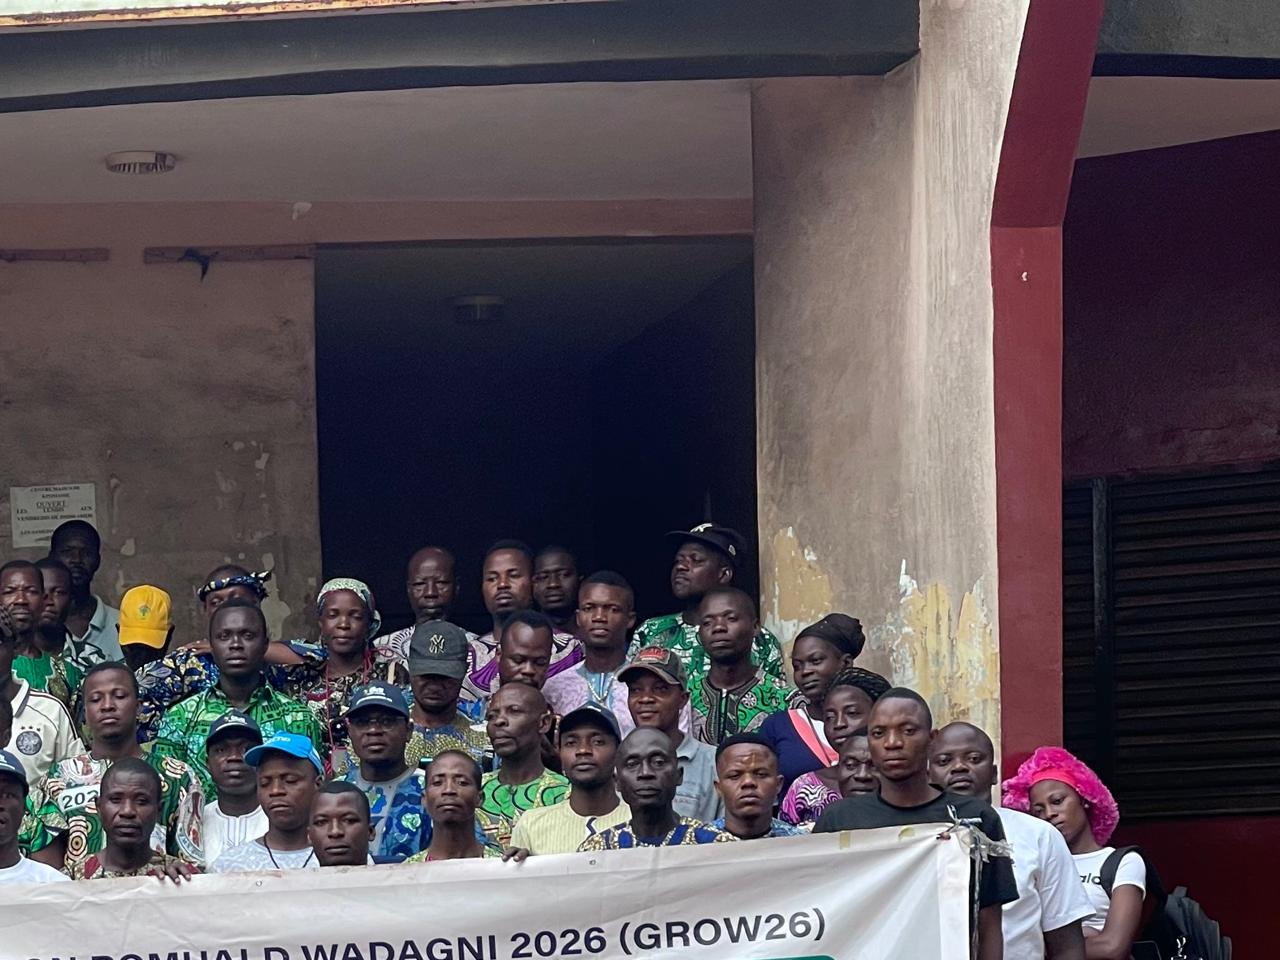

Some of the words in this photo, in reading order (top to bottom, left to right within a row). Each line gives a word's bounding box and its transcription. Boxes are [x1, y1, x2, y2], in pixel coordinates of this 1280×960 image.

[62, 790, 99, 810] 202
[510, 926, 607, 959] 2026
[620, 908, 825, 955] (GROW26)
